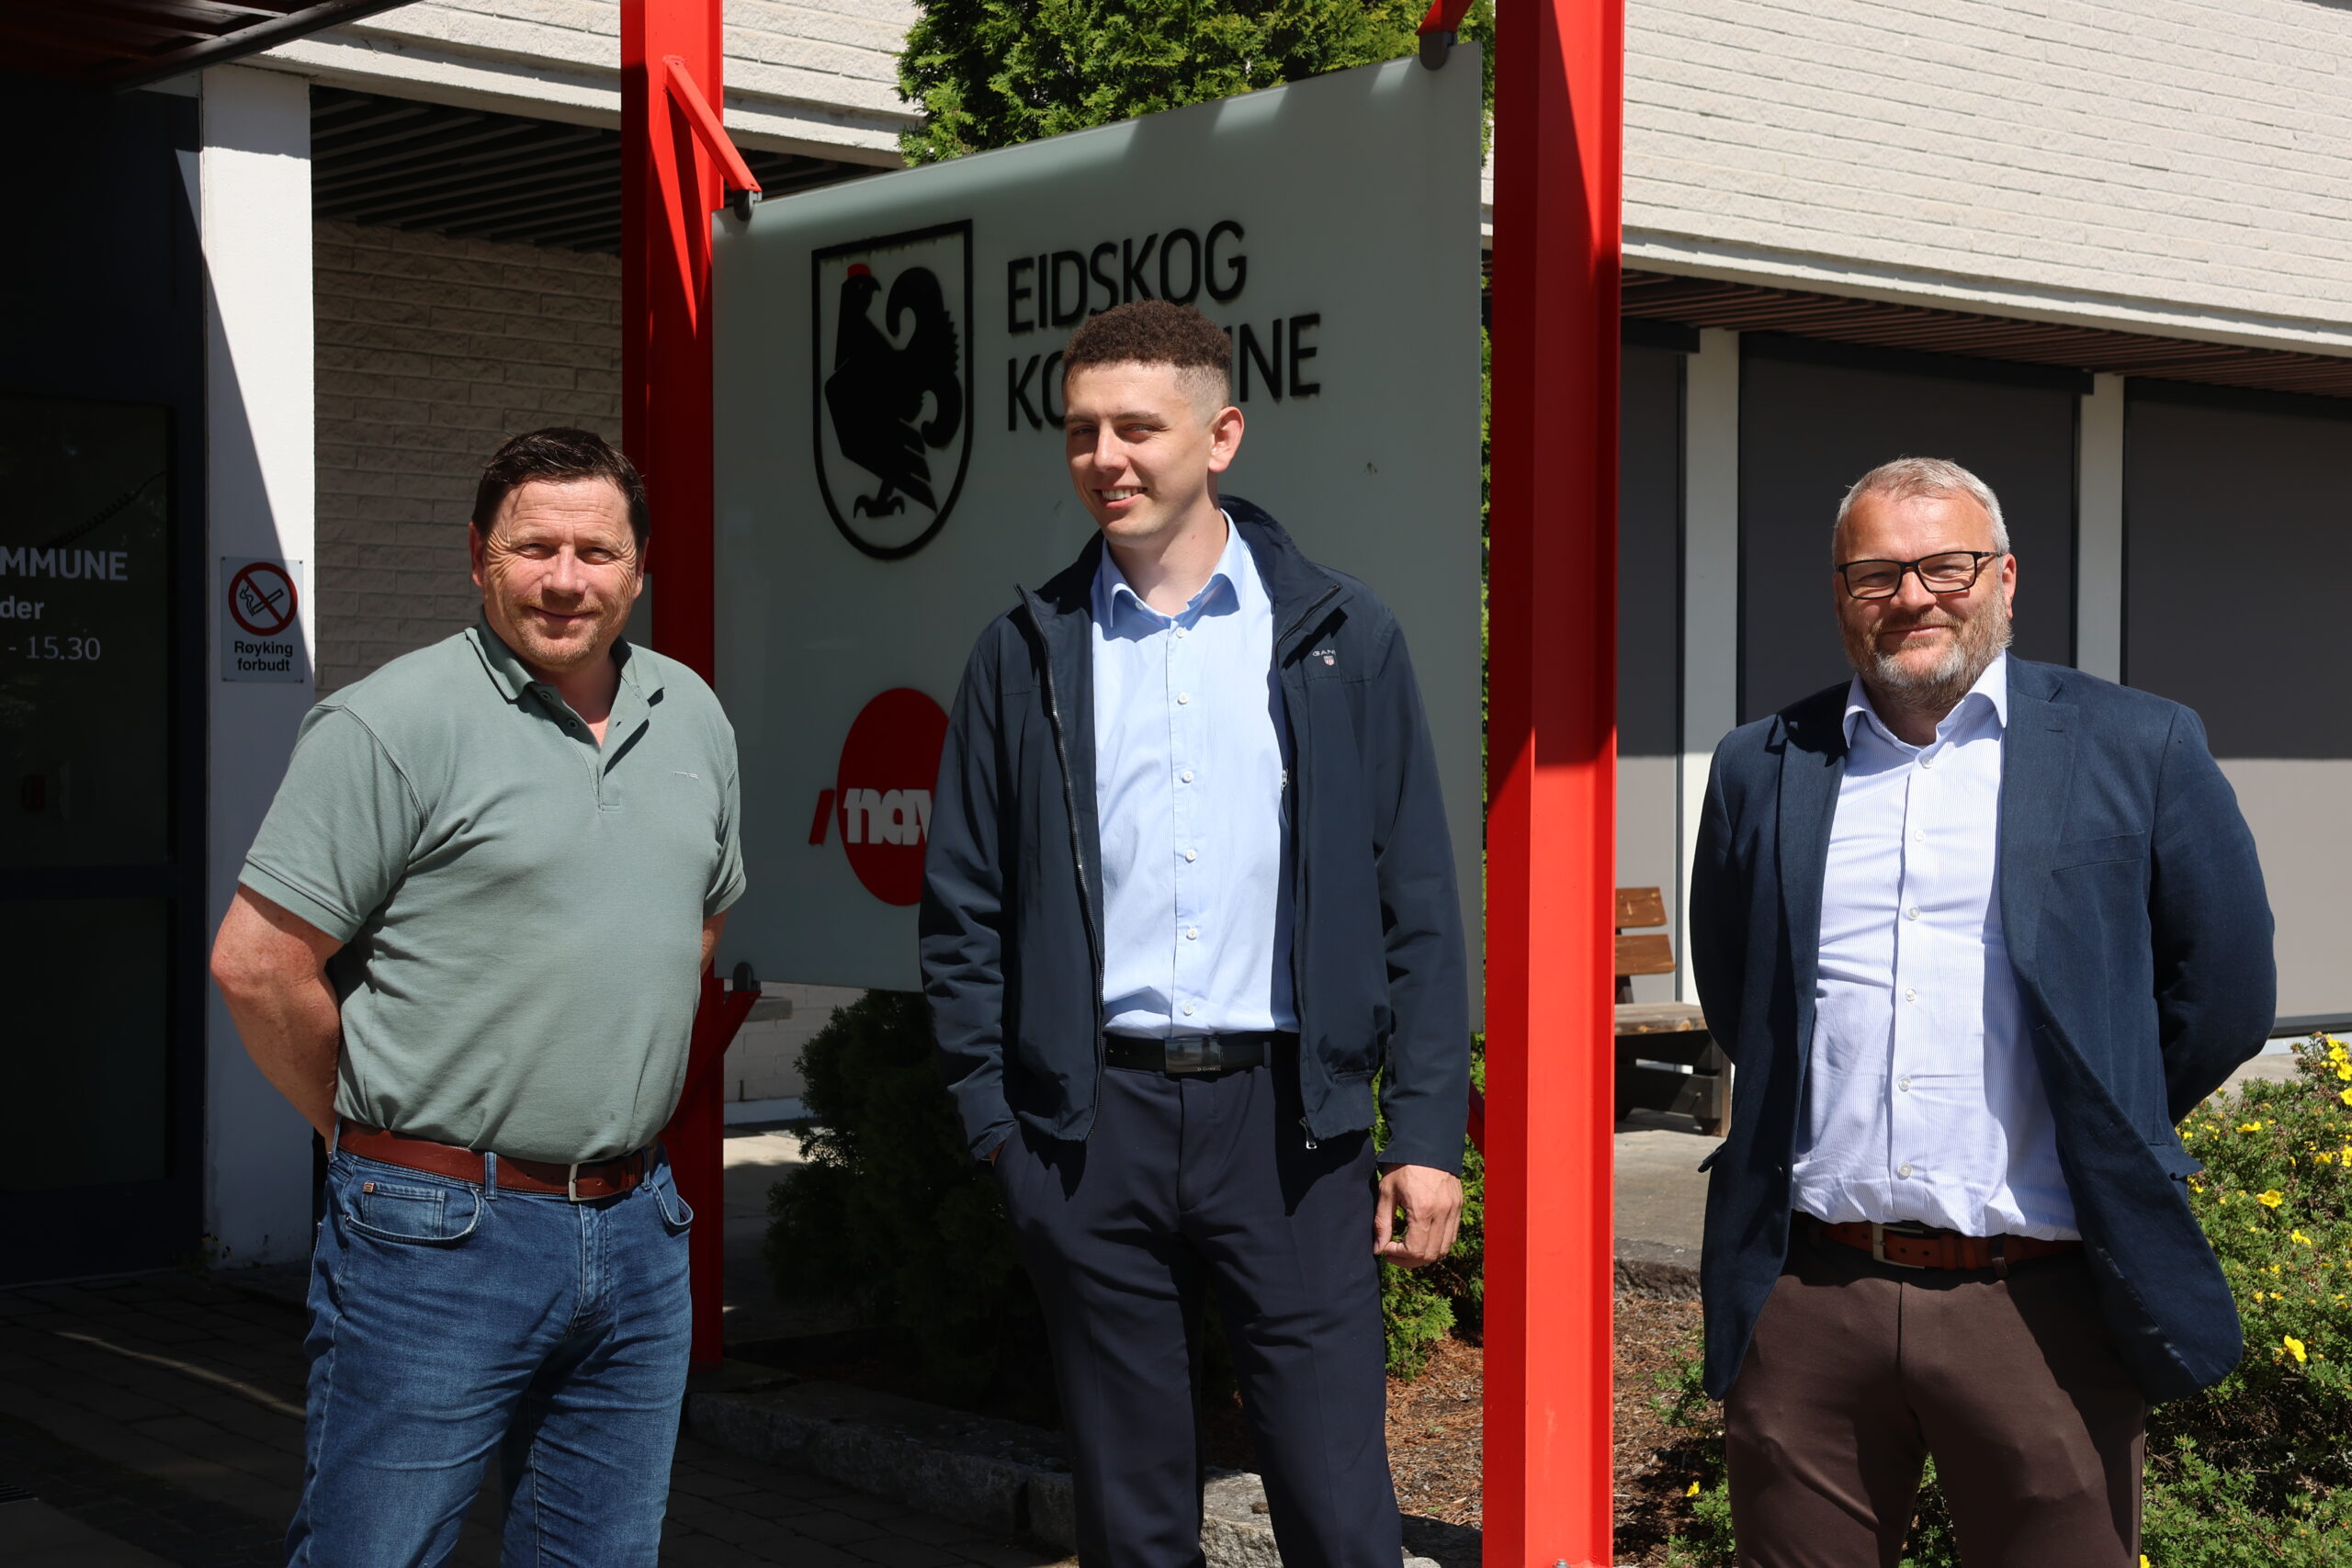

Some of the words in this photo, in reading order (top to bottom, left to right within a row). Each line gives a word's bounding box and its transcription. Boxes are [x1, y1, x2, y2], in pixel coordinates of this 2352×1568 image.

[1008, 220, 1247, 333] EIDSKOG
[1008, 313, 1320, 432] KONE
[0, 546, 129, 581] MMUNE
[0, 595, 45, 620] der
[27, 636, 101, 660] 15.30
[234, 640, 293, 657] Røyking
[237, 658, 290, 671] forbudt
